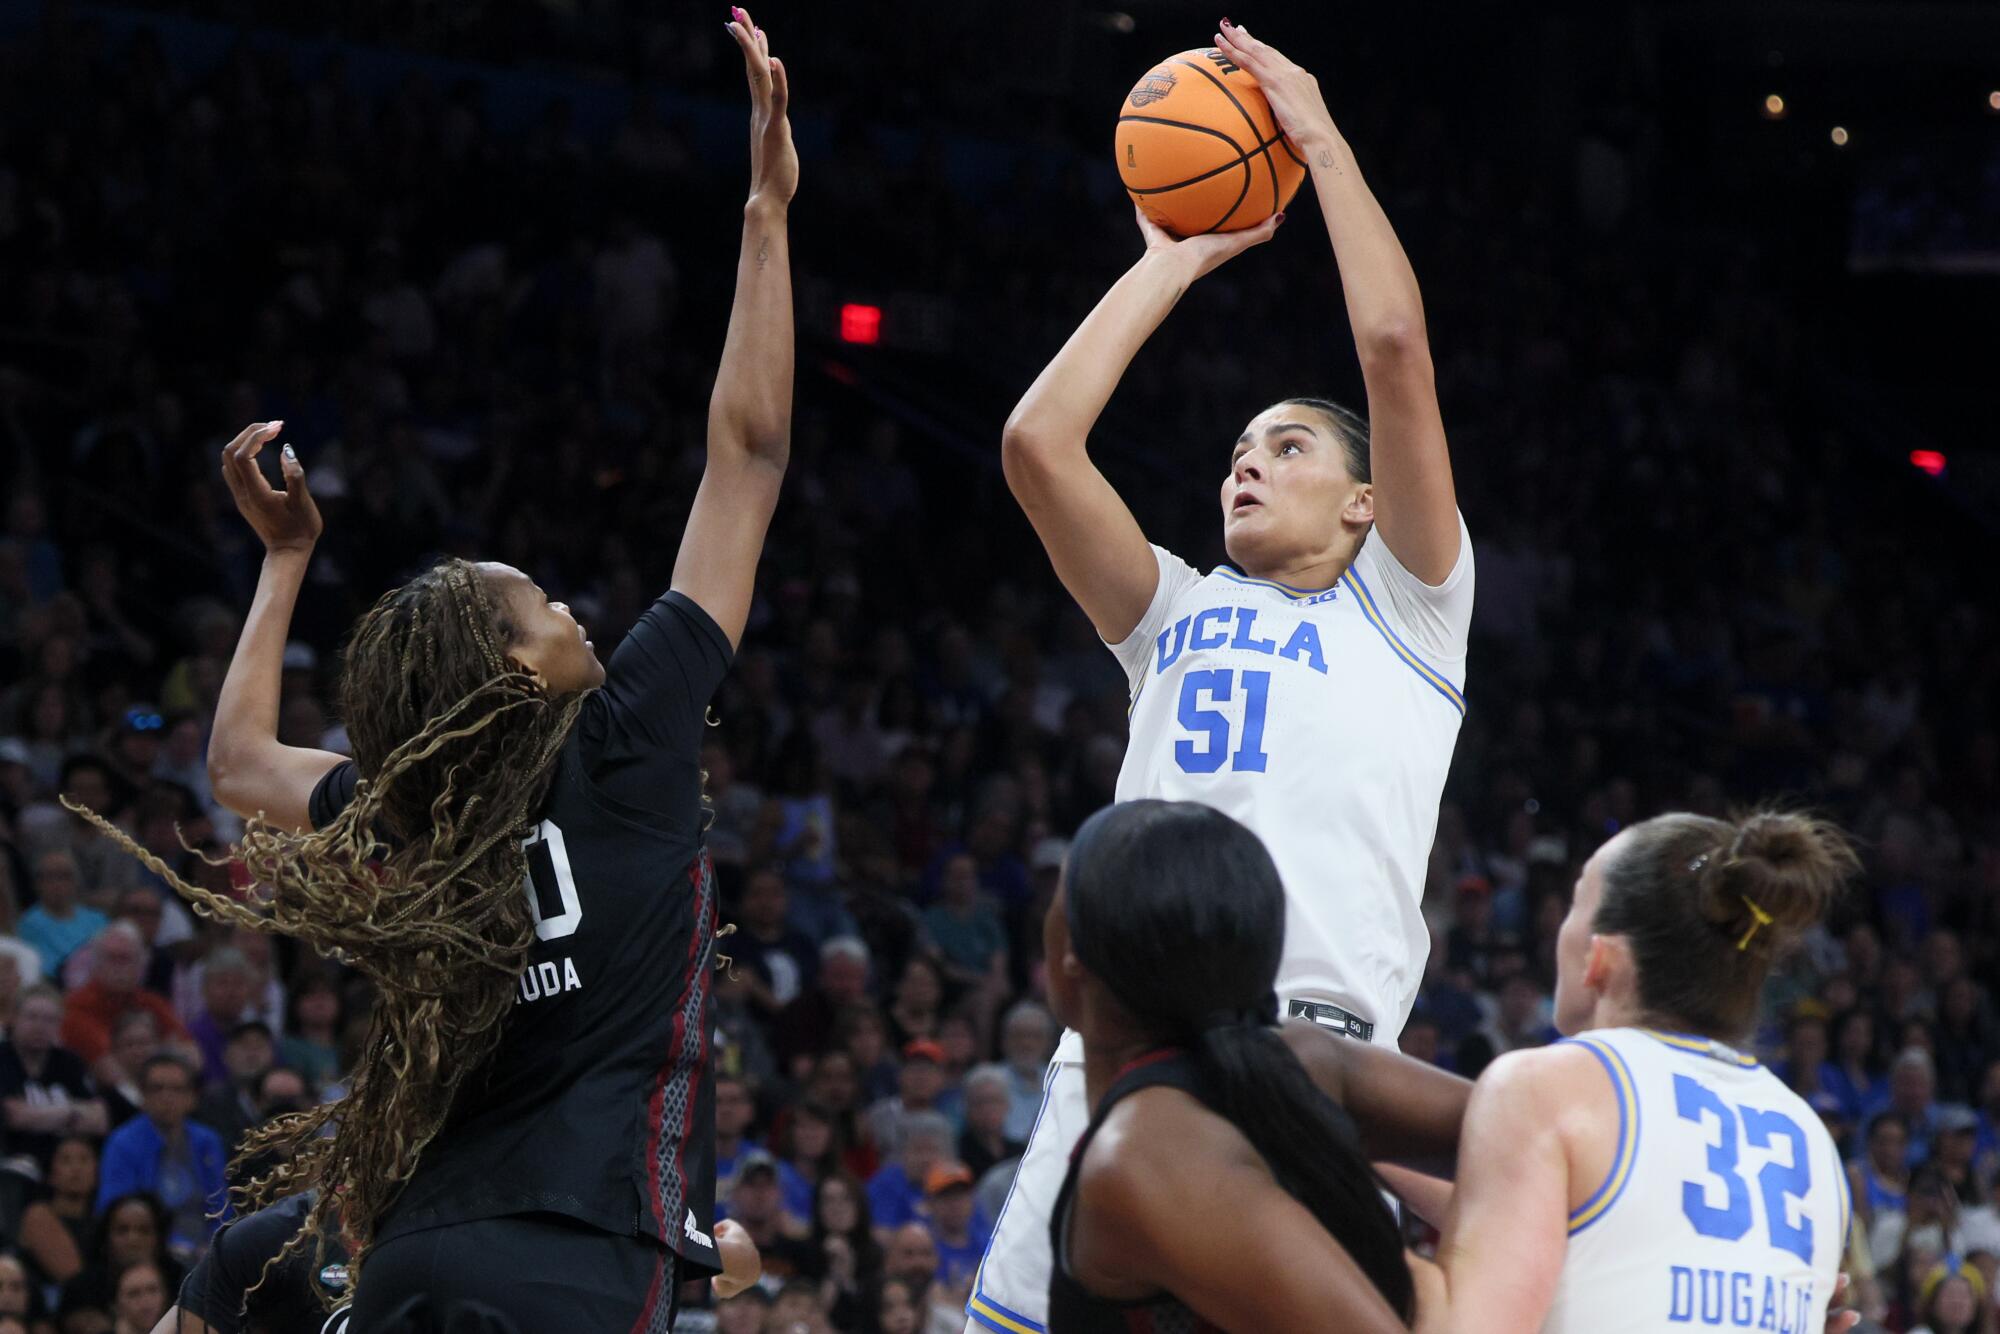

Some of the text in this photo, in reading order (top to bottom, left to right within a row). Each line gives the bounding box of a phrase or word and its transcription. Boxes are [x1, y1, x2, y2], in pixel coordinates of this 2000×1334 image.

[1156, 606, 1329, 675] UCLA
[1174, 668, 1271, 774] 51
[516, 957, 582, 1003] UDA
[1673, 1073, 1813, 1266] 32
